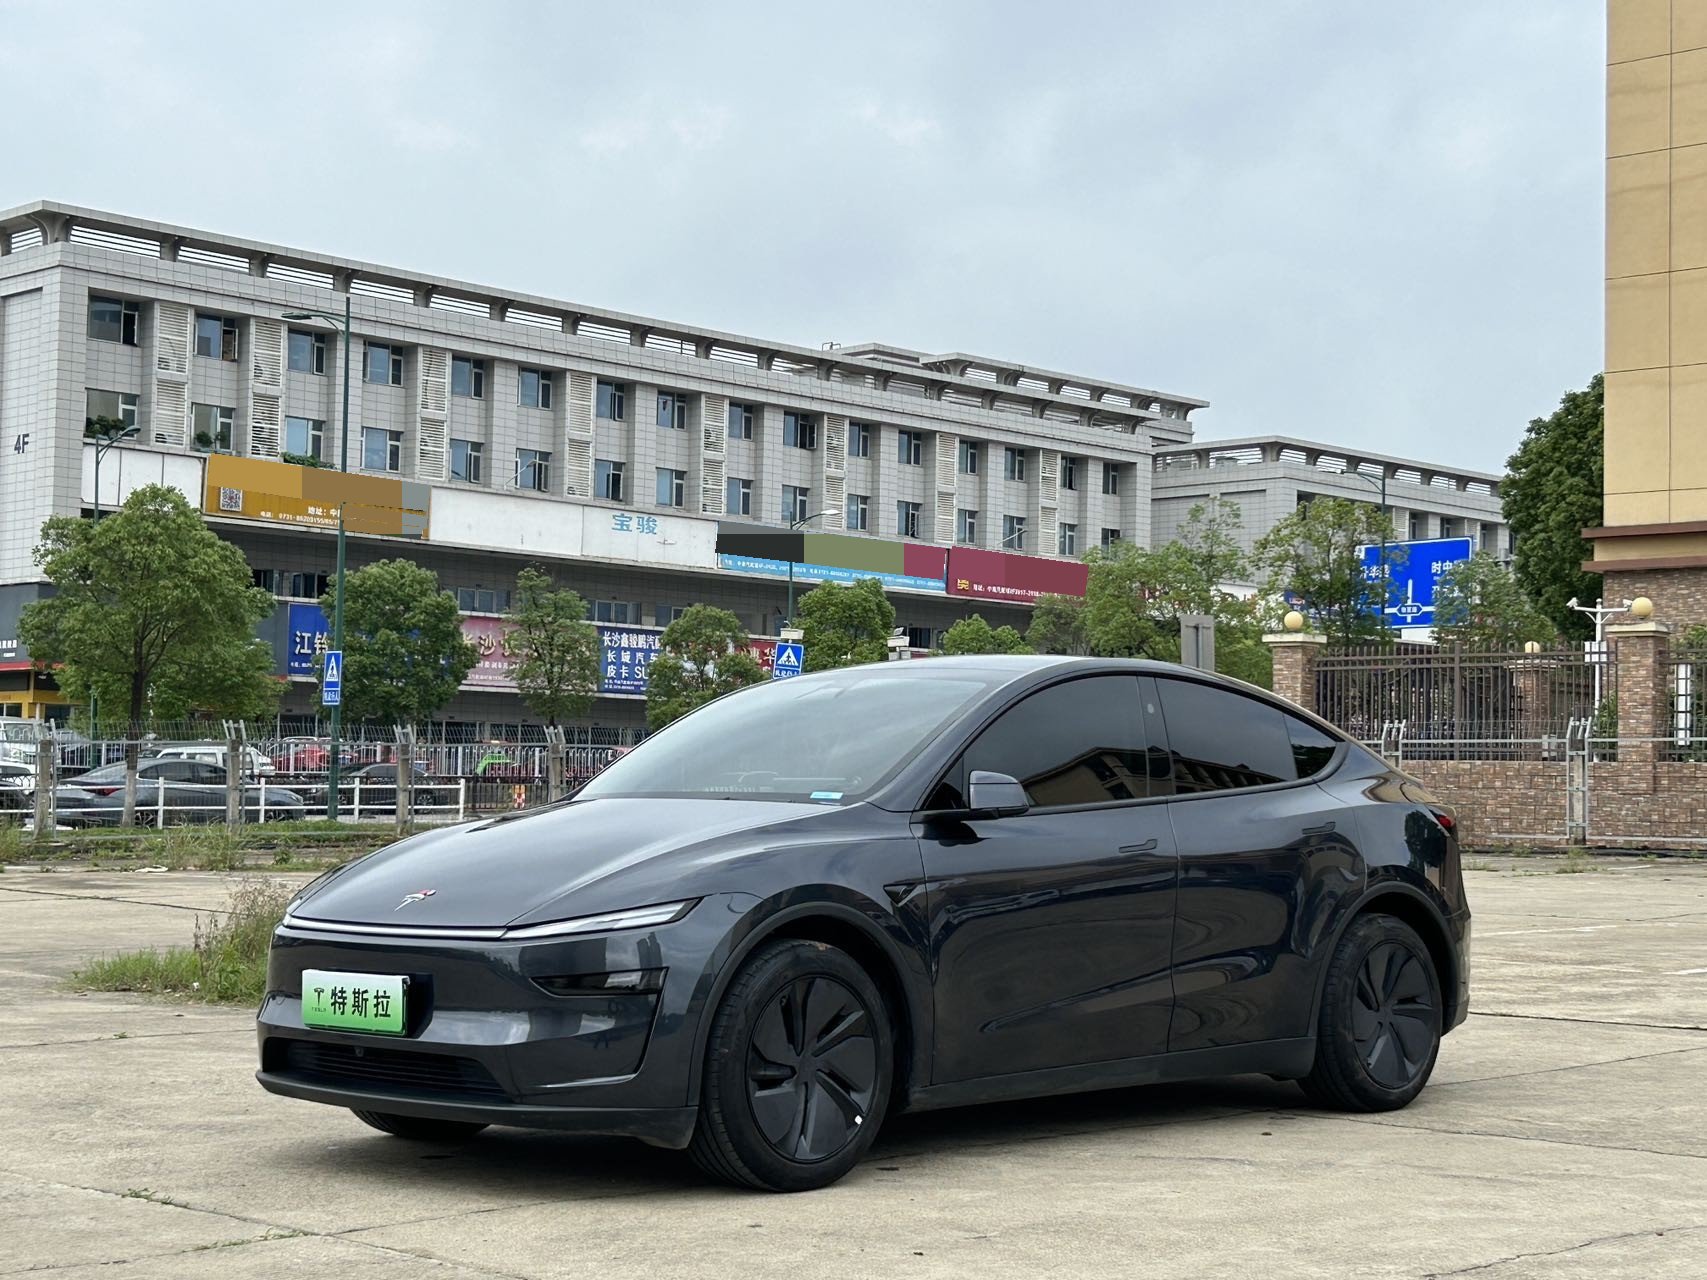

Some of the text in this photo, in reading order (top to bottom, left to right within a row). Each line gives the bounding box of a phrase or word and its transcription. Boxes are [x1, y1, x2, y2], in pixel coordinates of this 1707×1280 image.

[14, 433, 29, 454] 4F
[611, 512, 657, 535] 宝骏
[607, 665, 634, 679] 皮卡
[330, 985, 391, 1018] 特斯拉
